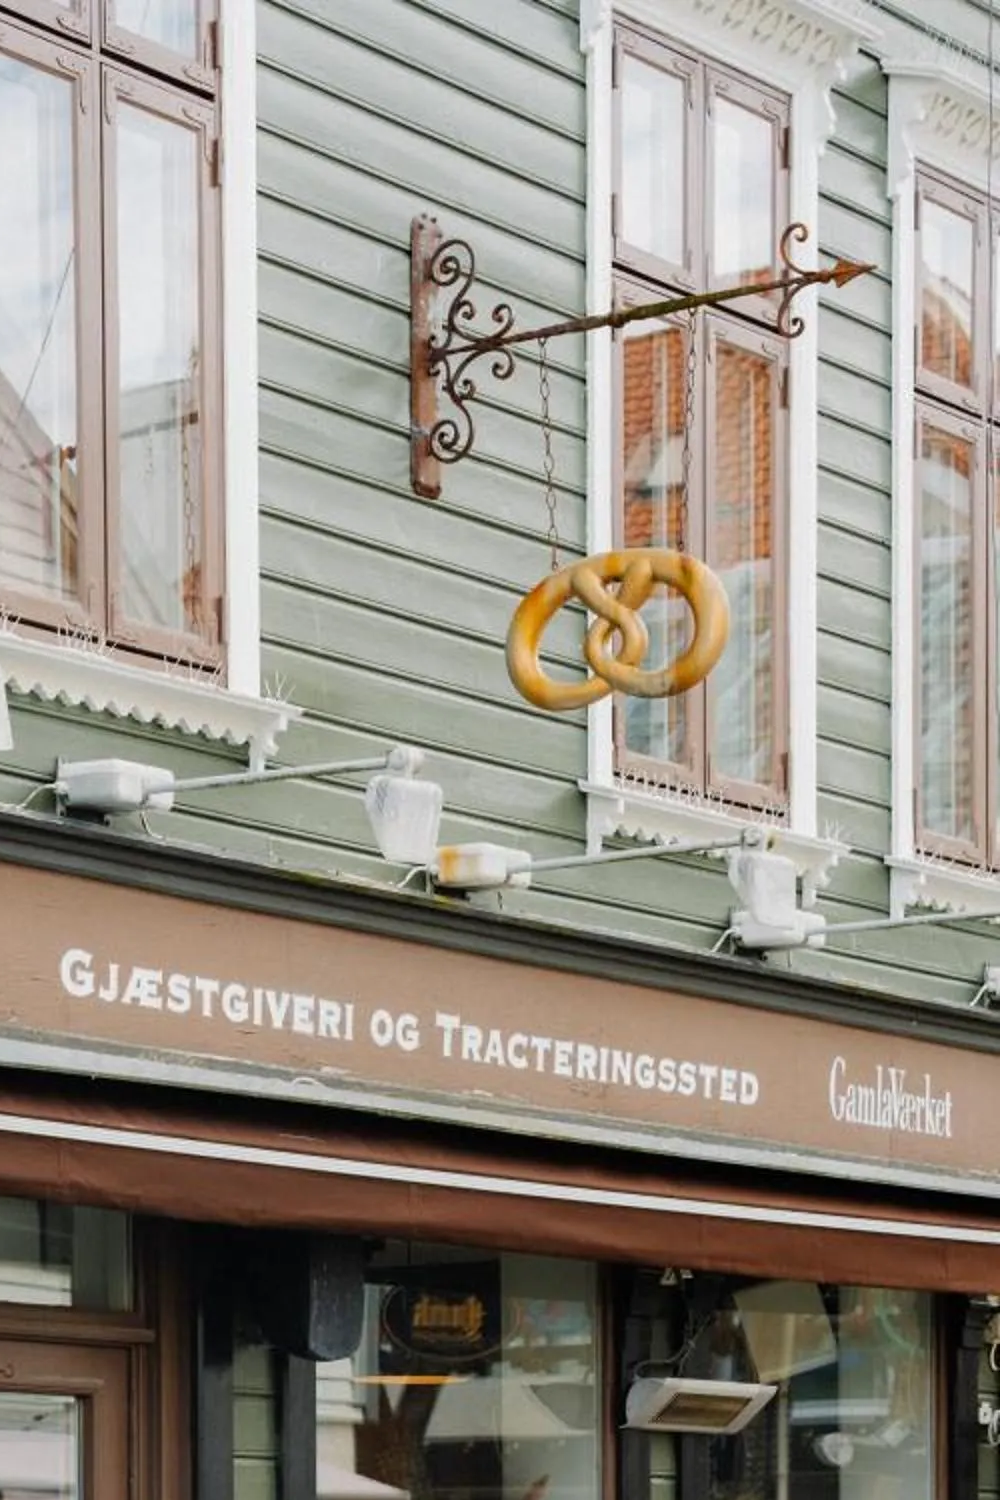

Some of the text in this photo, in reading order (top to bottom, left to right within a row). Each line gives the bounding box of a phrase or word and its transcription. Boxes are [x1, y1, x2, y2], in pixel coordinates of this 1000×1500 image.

[60, 948, 759, 1105] GJÆSTGIVERI OG TRACTERINGSSTED
